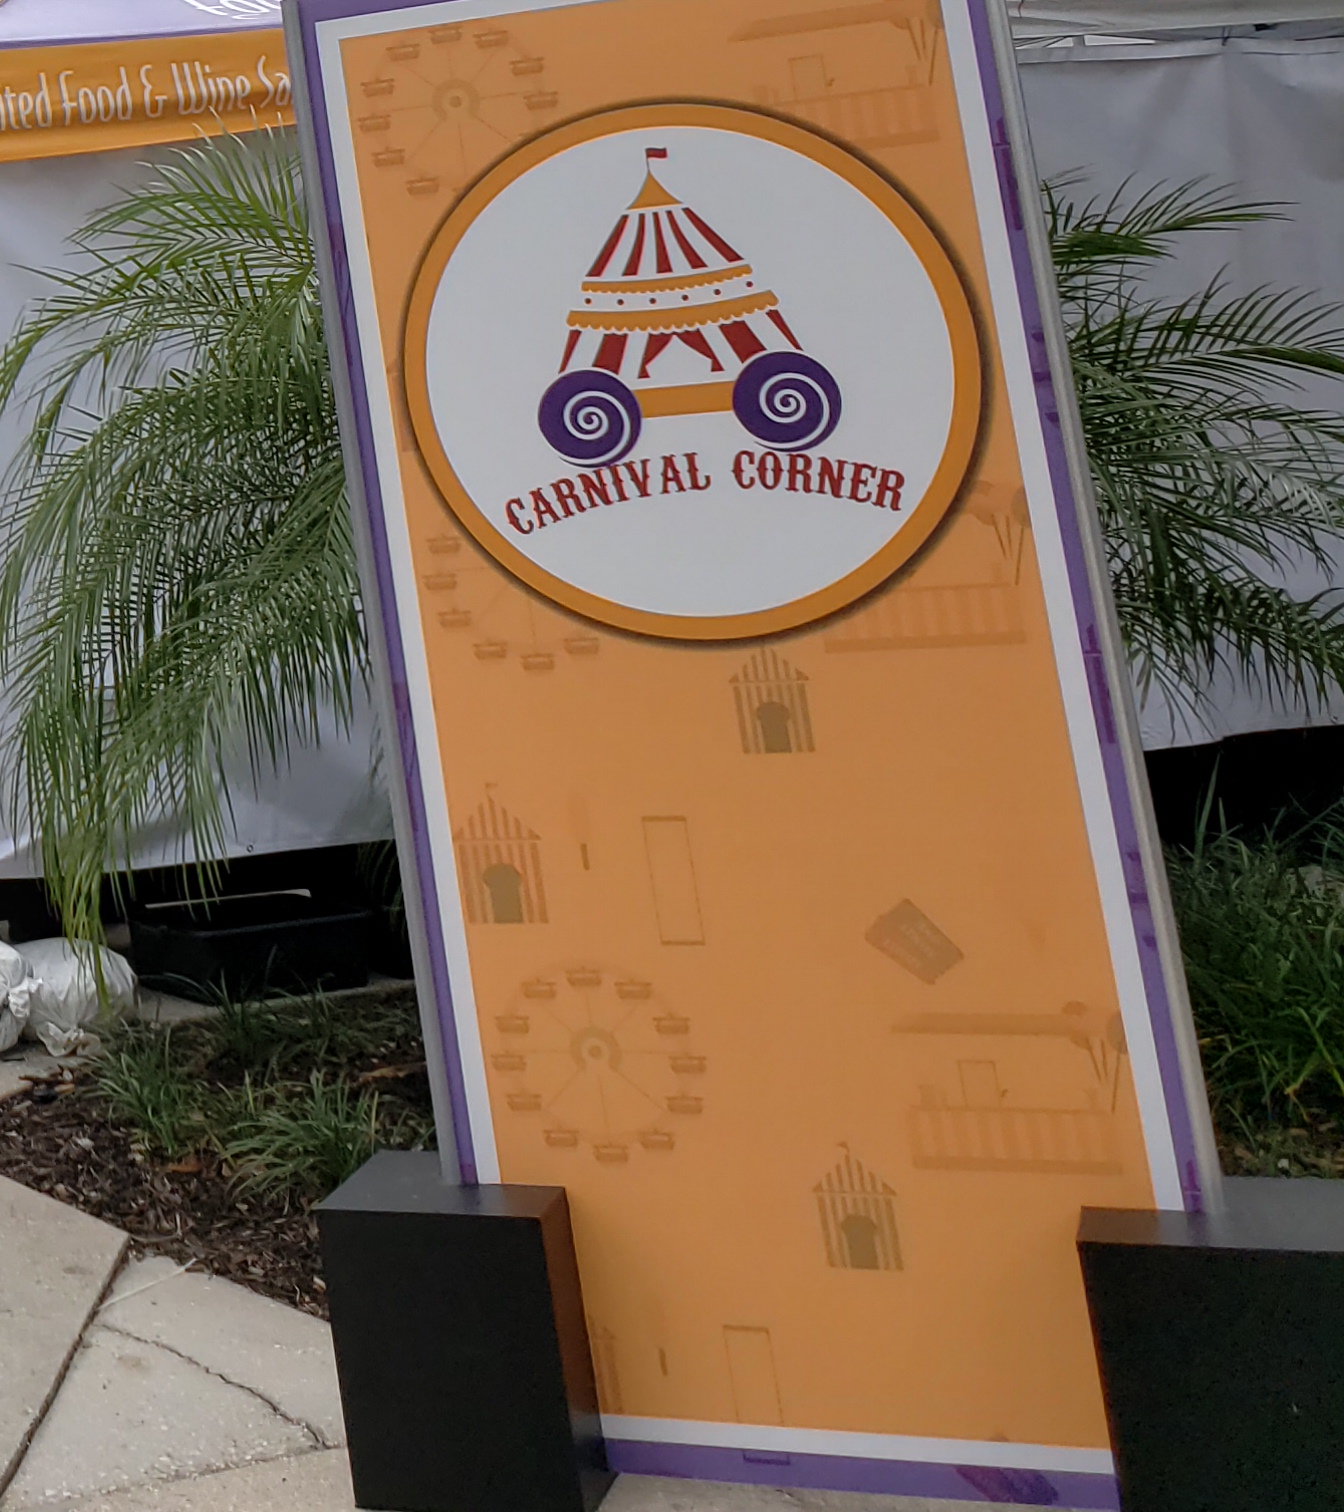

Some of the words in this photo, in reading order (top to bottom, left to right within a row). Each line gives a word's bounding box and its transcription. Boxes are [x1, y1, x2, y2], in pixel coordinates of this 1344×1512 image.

[58, 66, 132, 127] Food
[140, 64, 168, 119] &
[170, 61, 252, 116] Wine
[504, 450, 711, 535] CARNIVAL
[732, 449, 906, 512] CORNER
